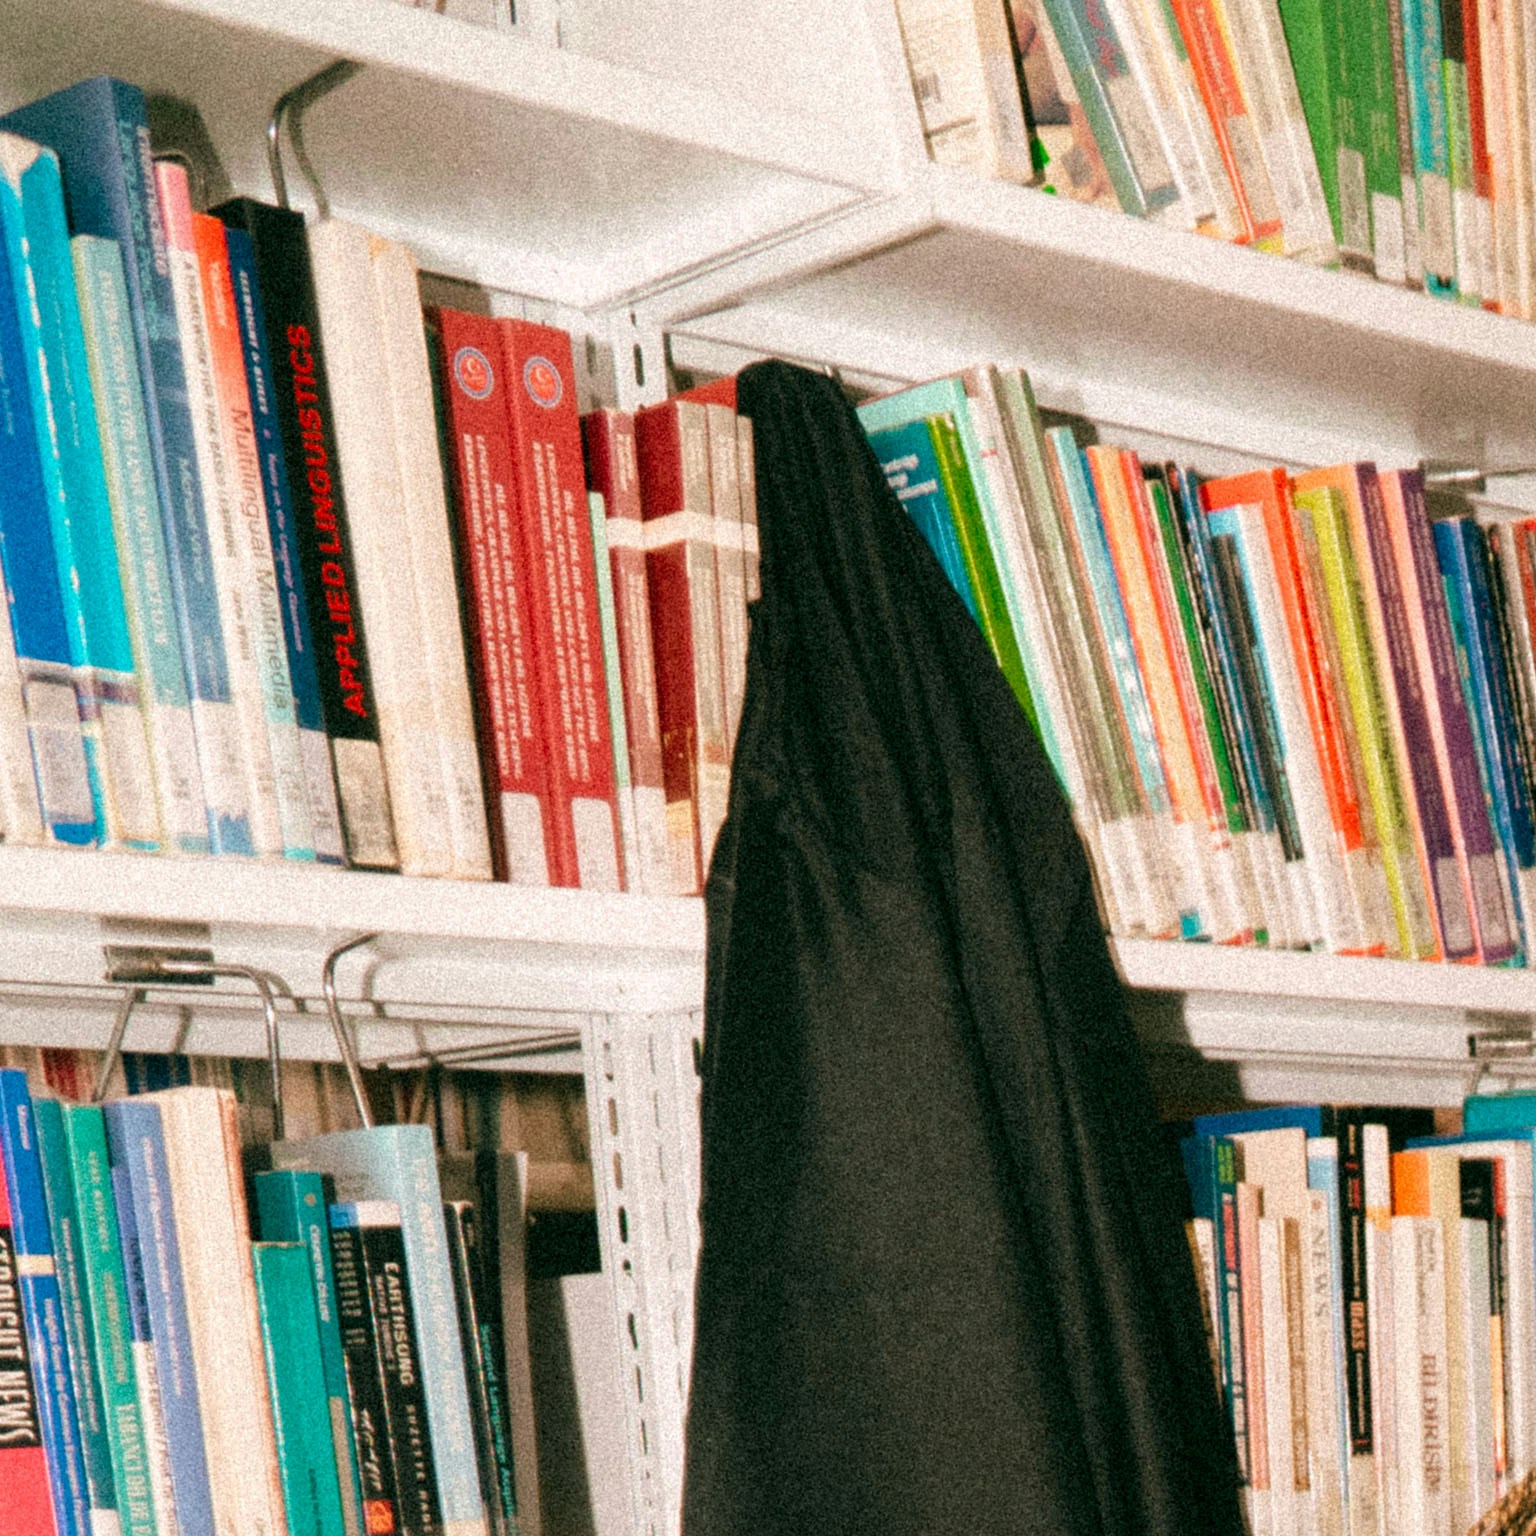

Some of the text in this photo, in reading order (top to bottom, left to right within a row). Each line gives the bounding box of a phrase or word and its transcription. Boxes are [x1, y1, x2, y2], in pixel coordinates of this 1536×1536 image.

[224, 406, 297, 710] Multilingual Multimedia
[283, 321, 368, 719] APPLIED LINGUISTICS
[1309, 1225, 1330, 1319] NEWS
[381, 1260, 418, 1387] EARTHSONG
[479, 1323, 498, 1382] Second
[0, 1370, 37, 1446] NEWS
[486, 1386, 509, 1463] Language
